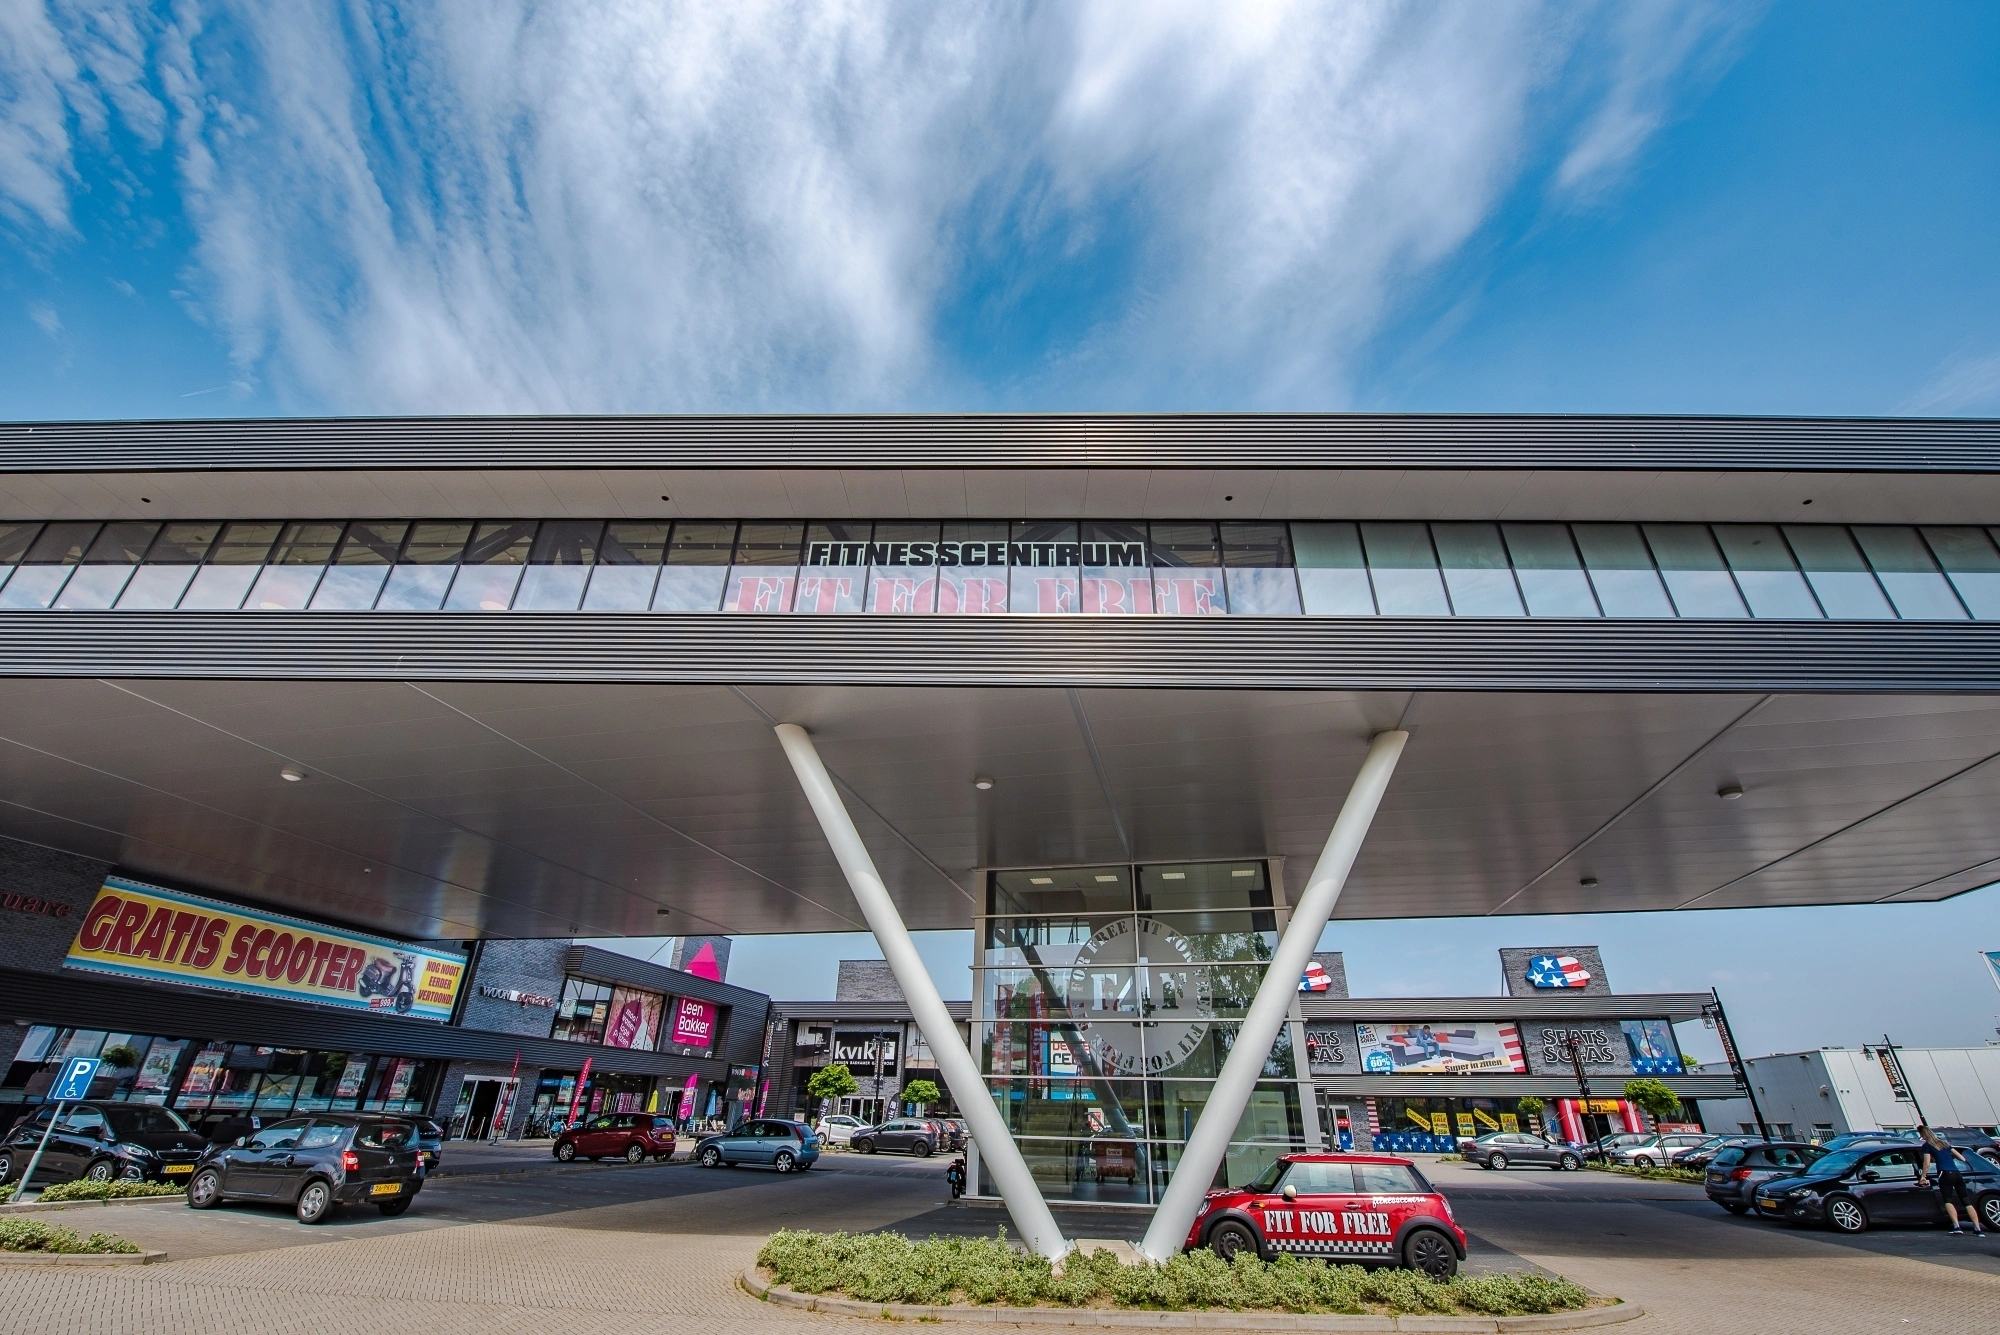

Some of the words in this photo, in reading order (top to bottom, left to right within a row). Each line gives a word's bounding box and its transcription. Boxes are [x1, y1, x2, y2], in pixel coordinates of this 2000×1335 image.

[808, 541, 1146, 568] FITNESSCENTRUM
[735, 577, 852, 613] FIT
[873, 577, 1008, 613] FOR
[1034, 578, 1216, 614] FREE
[79, 895, 229, 969] GRATIS
[222, 924, 366, 991] SCOOTER
[426, 961, 440, 973] NOG
[440, 964, 460, 977] NOOIT
[428, 976, 452, 990] EERDER
[682, 999, 704, 1017] Leen
[678, 1015, 709, 1034] Bakker
[835, 1041, 875, 1060] kvik
[69, 1061, 92, 1082] P
[1445, 1064, 1470, 1072] Super
[1479, 1059, 1503, 1068] zitten
[1264, 1211, 1294, 1233] FIT
[1299, 1211, 1338, 1234] FOR
[1341, 1212, 1392, 1236] FREE
